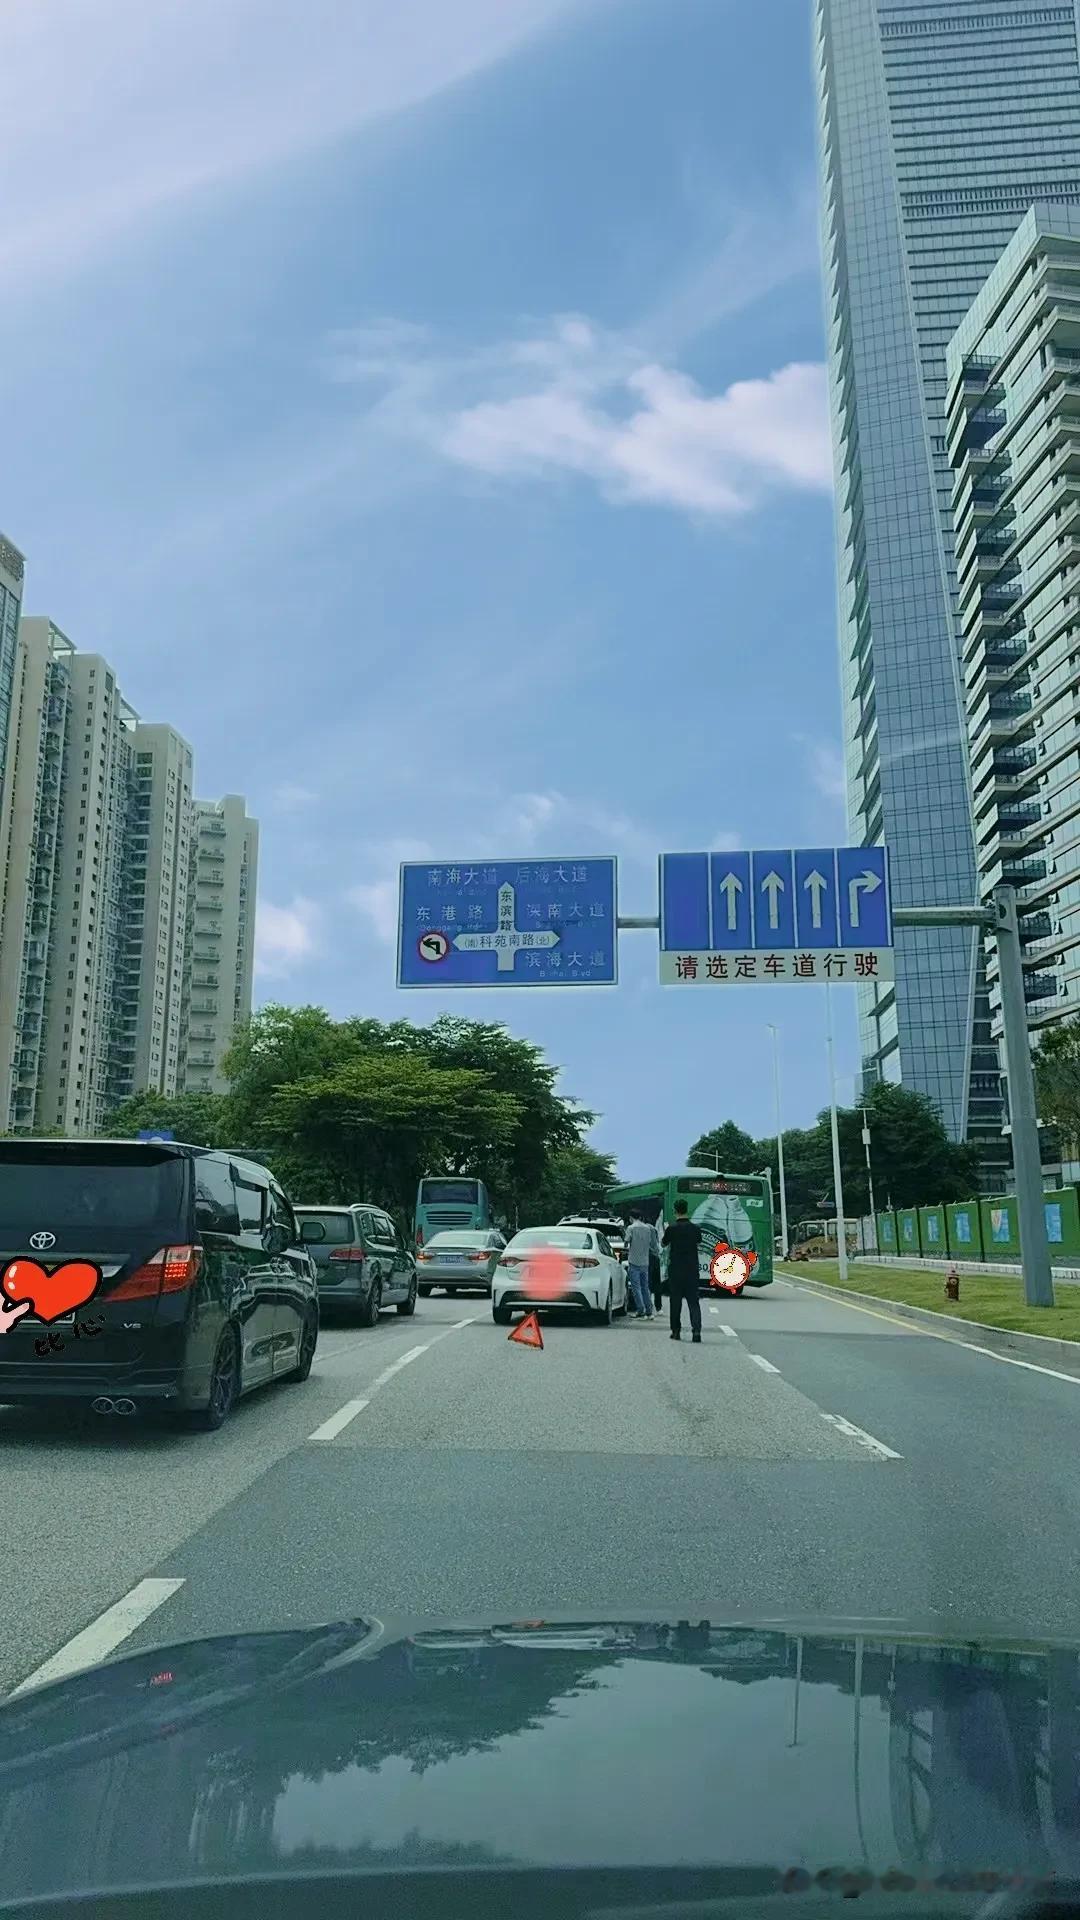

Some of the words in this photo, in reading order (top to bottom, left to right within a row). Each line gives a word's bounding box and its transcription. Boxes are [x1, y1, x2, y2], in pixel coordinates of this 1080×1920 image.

[416, 904, 484, 921] 东港路
[501, 890, 513, 931] 东滨路
[525, 950, 606, 968] 滨海大道
[675, 952, 878, 979] 请选定车道行驶
